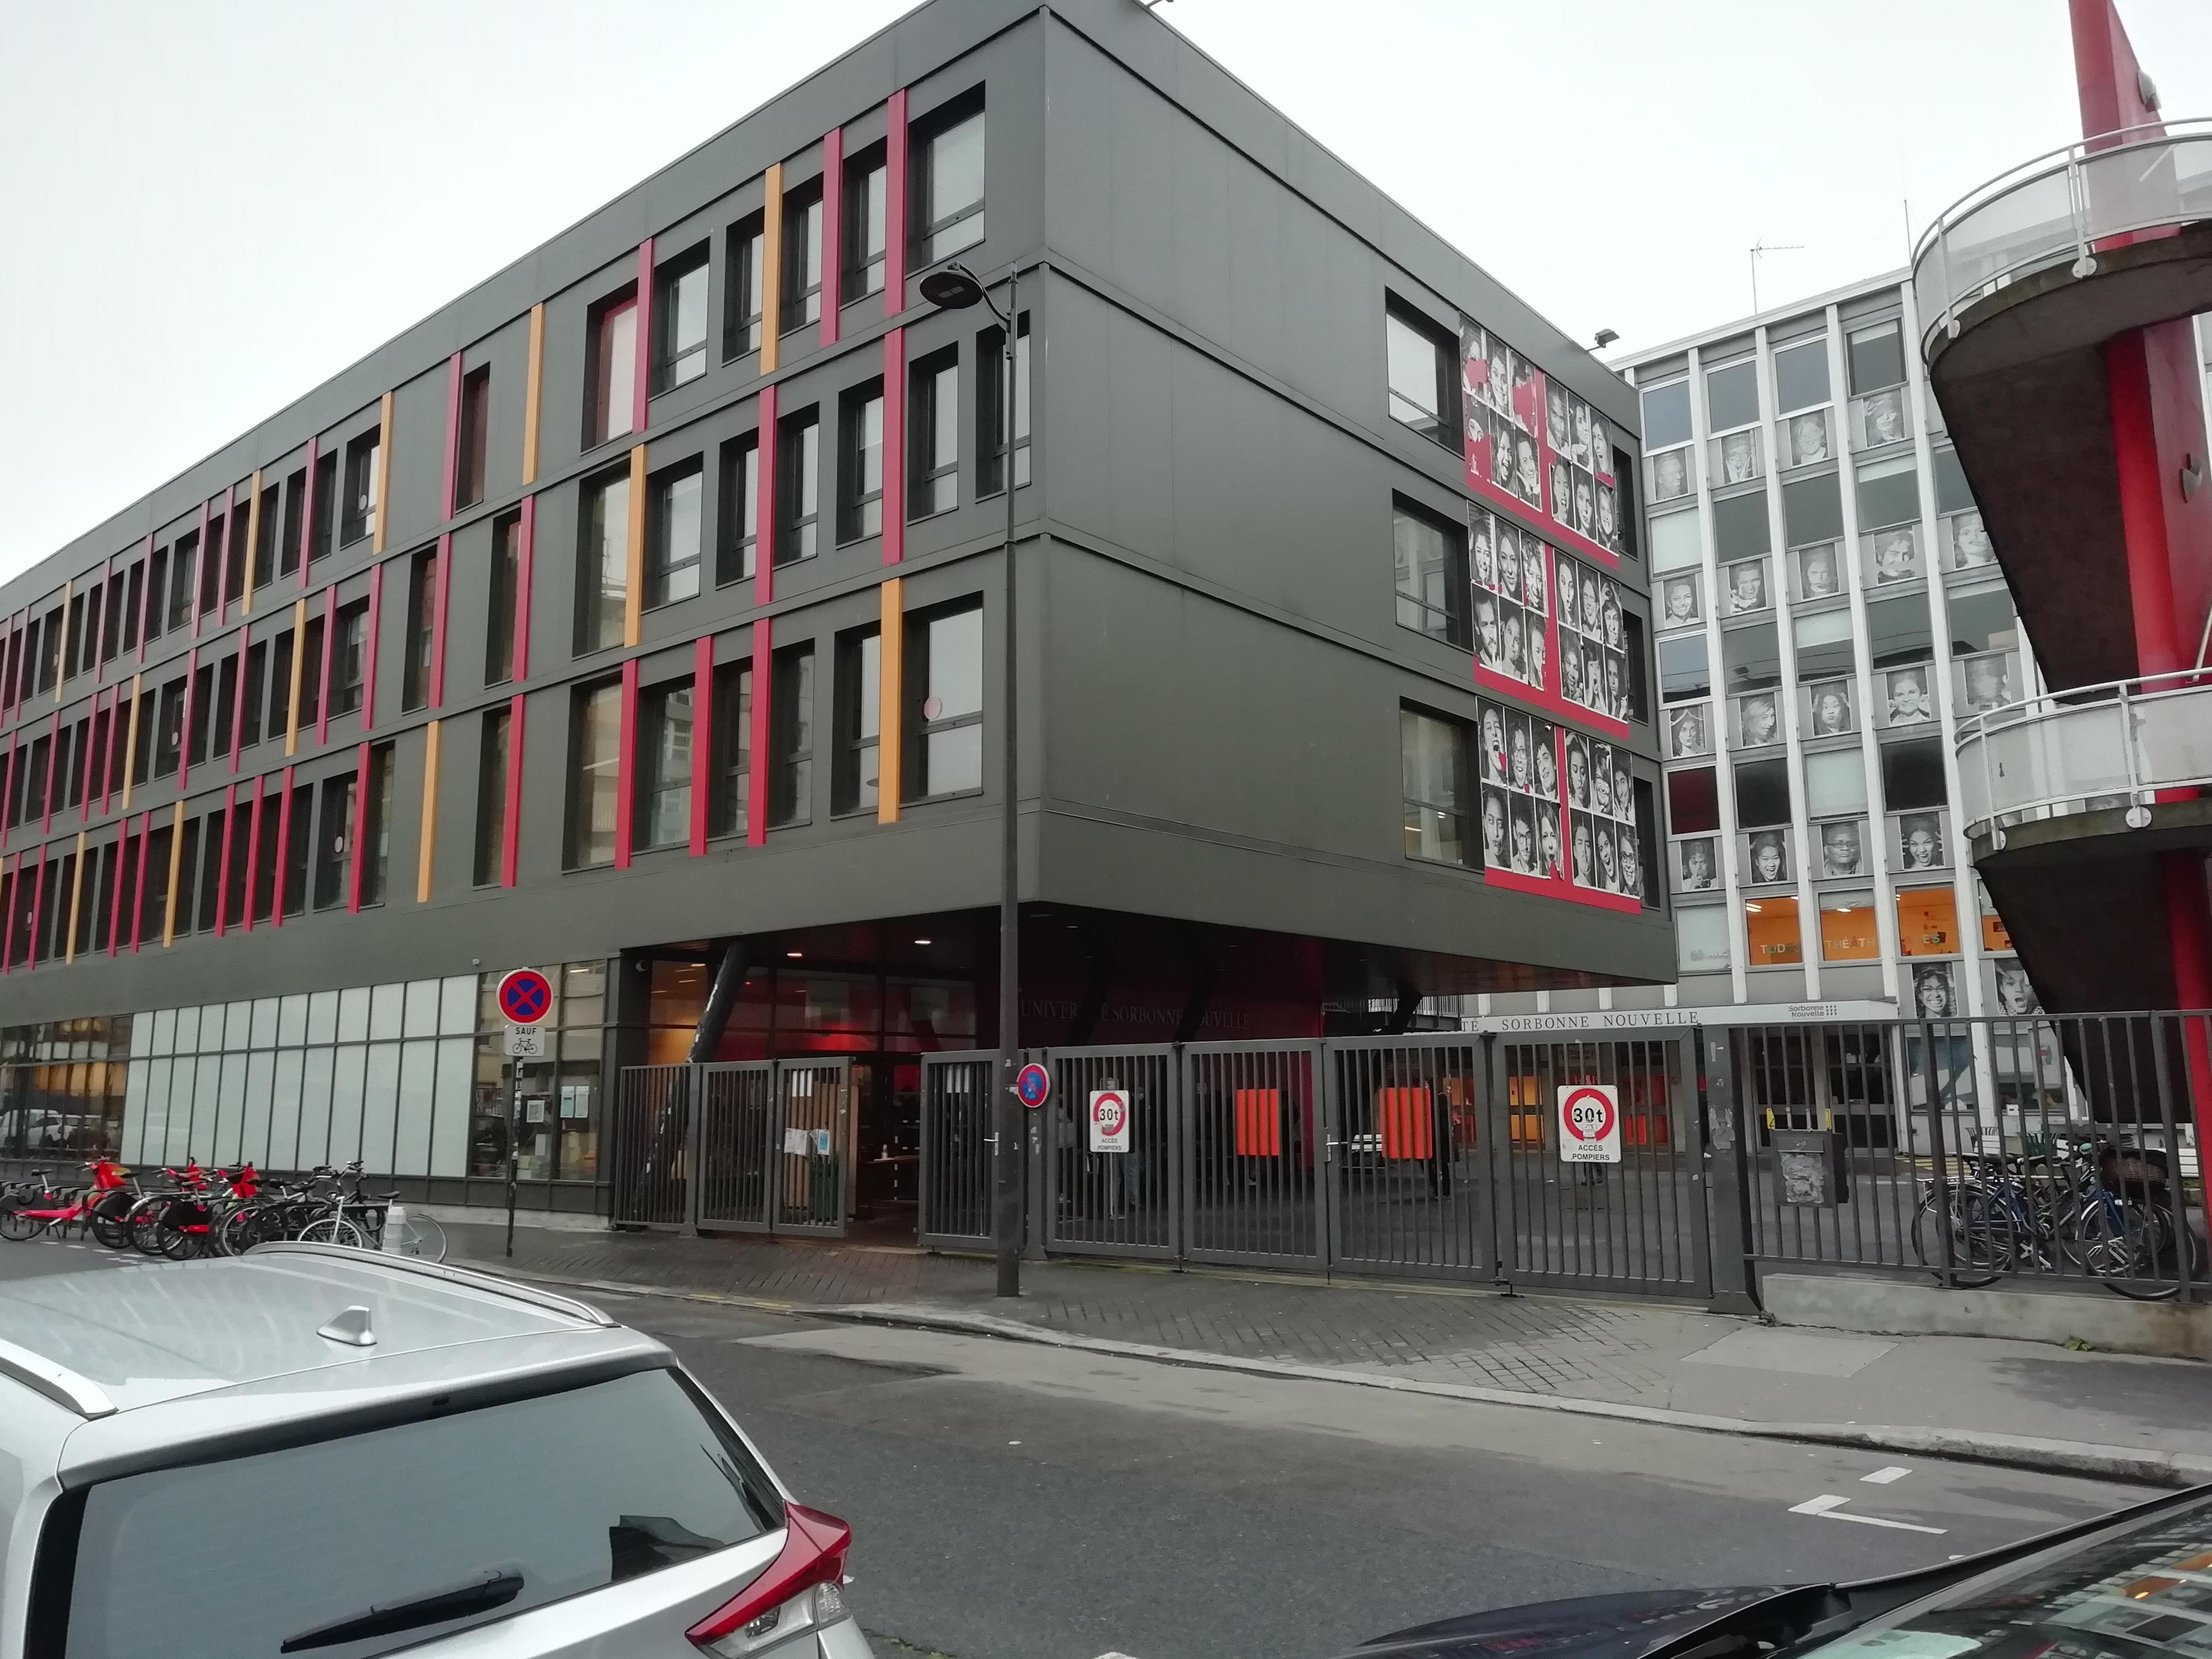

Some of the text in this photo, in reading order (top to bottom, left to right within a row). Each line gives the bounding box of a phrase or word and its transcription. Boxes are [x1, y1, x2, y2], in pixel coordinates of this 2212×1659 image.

[1020, 999, 1108, 1021] UNIVERÉ
[1502, 1016, 1589, 1031] SORBONNE
[1603, 1011, 1699, 1027] NOUVELLE
[515, 1027, 536, 1035] SAUF
[1099, 1108, 1118, 1120] 30t
[1573, 1108, 1603, 1123] 30t
